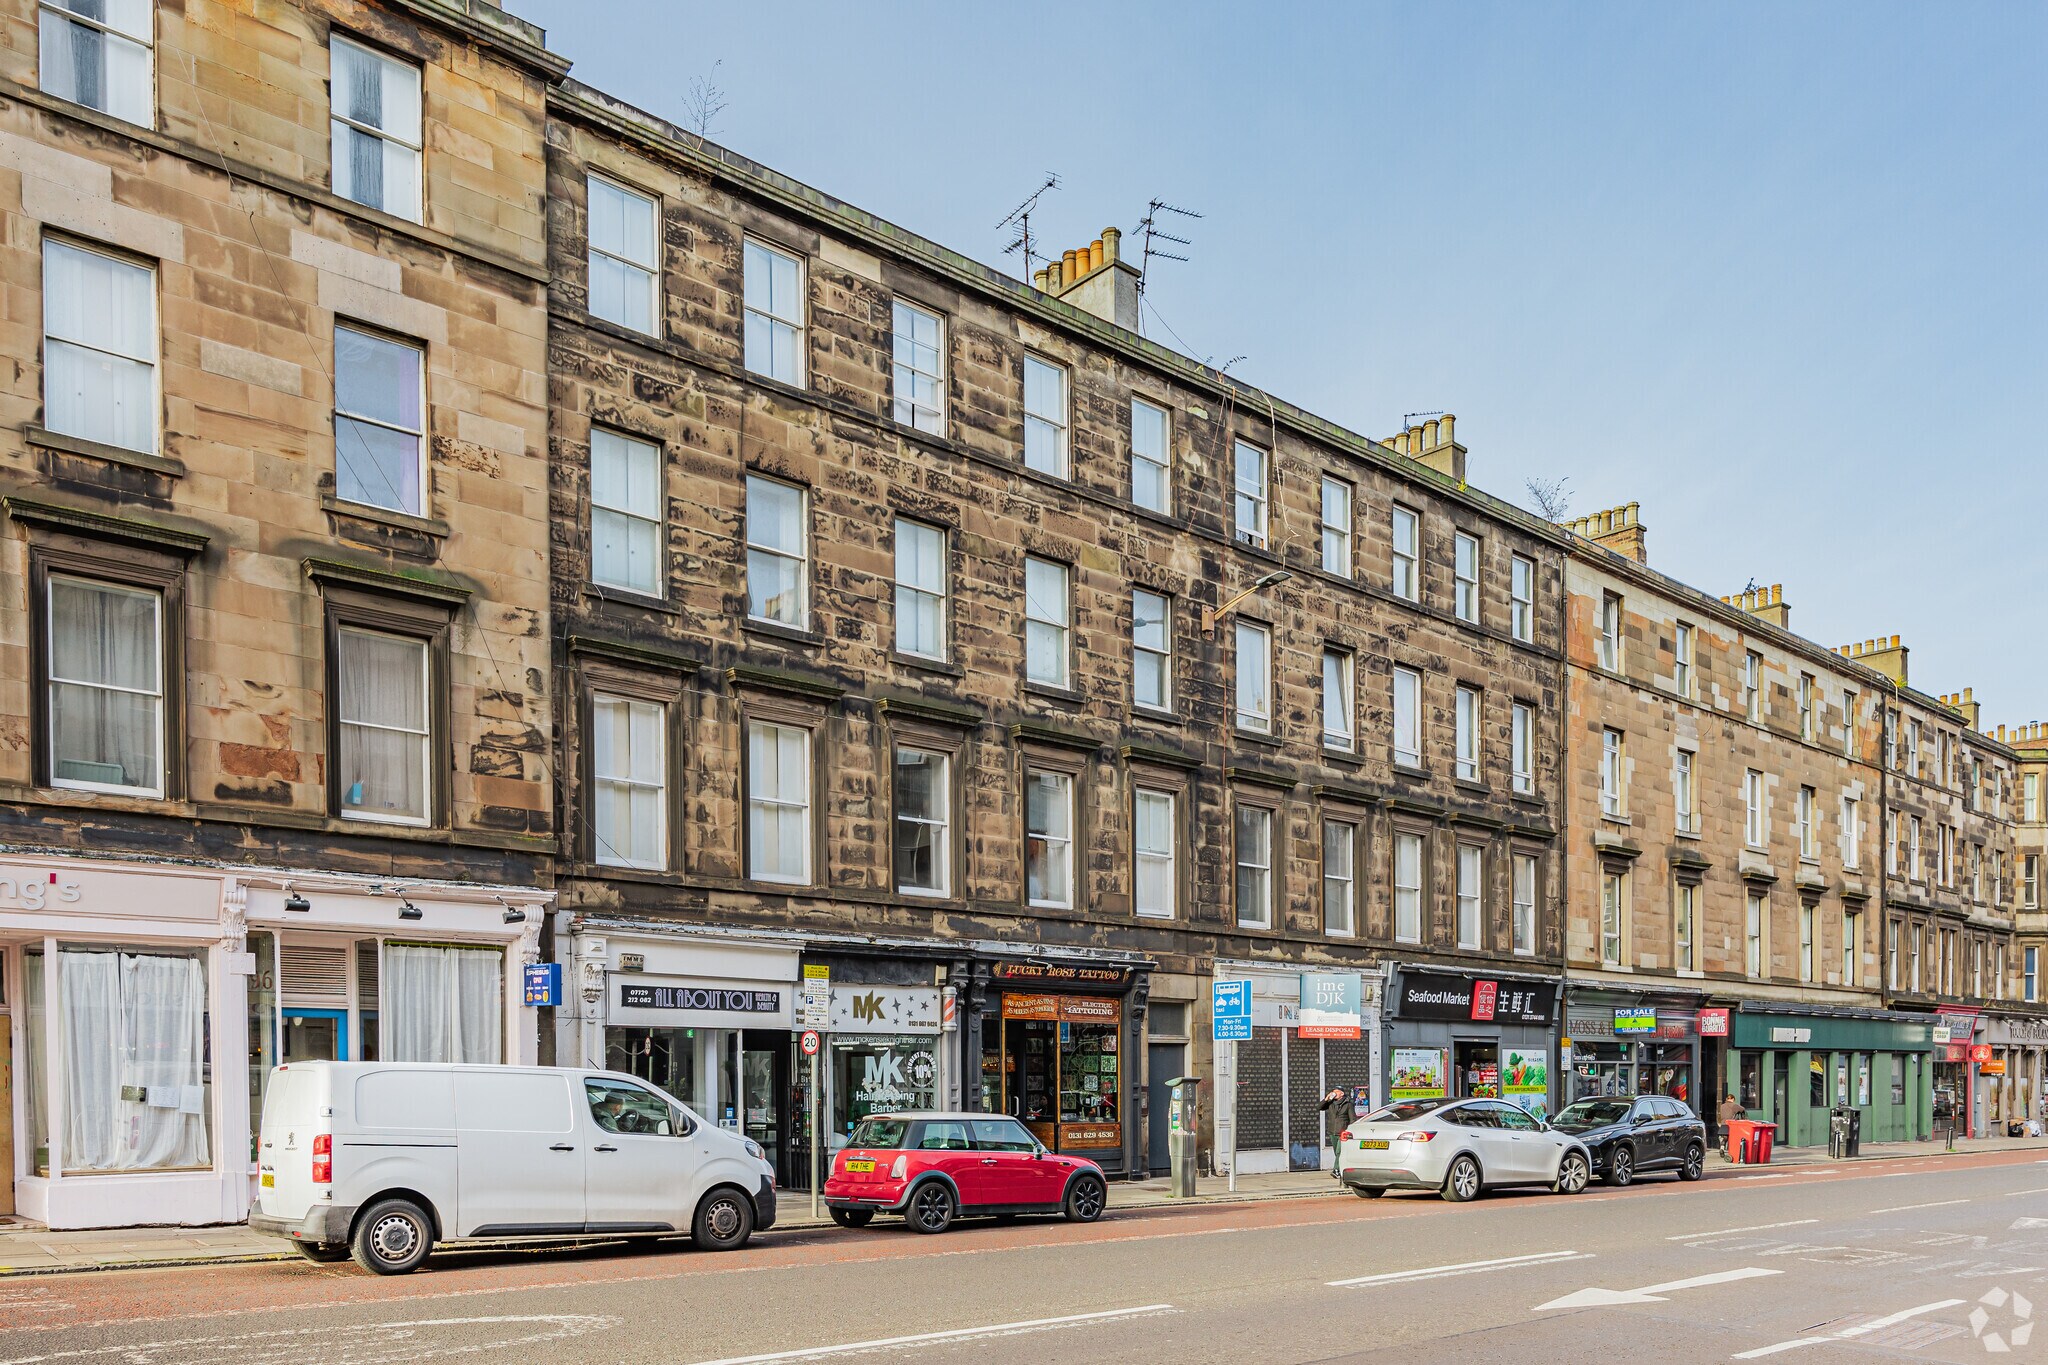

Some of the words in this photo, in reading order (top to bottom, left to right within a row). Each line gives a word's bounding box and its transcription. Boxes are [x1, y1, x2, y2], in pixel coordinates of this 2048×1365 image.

[1007, 964, 1045, 976] LUCKY
[1047, 967, 1076, 978] ROSE
[1079, 969, 1119, 980] TATTOO
[1317, 979, 1345, 991] ime
[655, 988, 675, 1007] ALL
[676, 989, 721, 1009] ABOUT
[723, 990, 752, 1011] YOU
[807, 996, 813, 1004] P
[1316, 992, 1345, 1007] DJK
[1408, 989, 1442, 1003] Seafood
[1443, 991, 1470, 1006] Market
[1499, 990, 1536, 1014] 生鲜汇
[853, 989, 886, 1026] MK
[1065, 1004, 1113, 1016] TATTOOING
[1082, 1001, 1113, 1009] ELECTRIC
[1615, 1009, 1632, 1017] FOR
[1633, 1008, 1654, 1016] SALE
[1701, 1016, 1725, 1026] BONNIE
[1701, 1025, 1726, 1033] BURRITO
[804, 1037, 816, 1047] 20
[864, 1049, 905, 1090] MK
[915, 1063, 932, 1079] 10%
